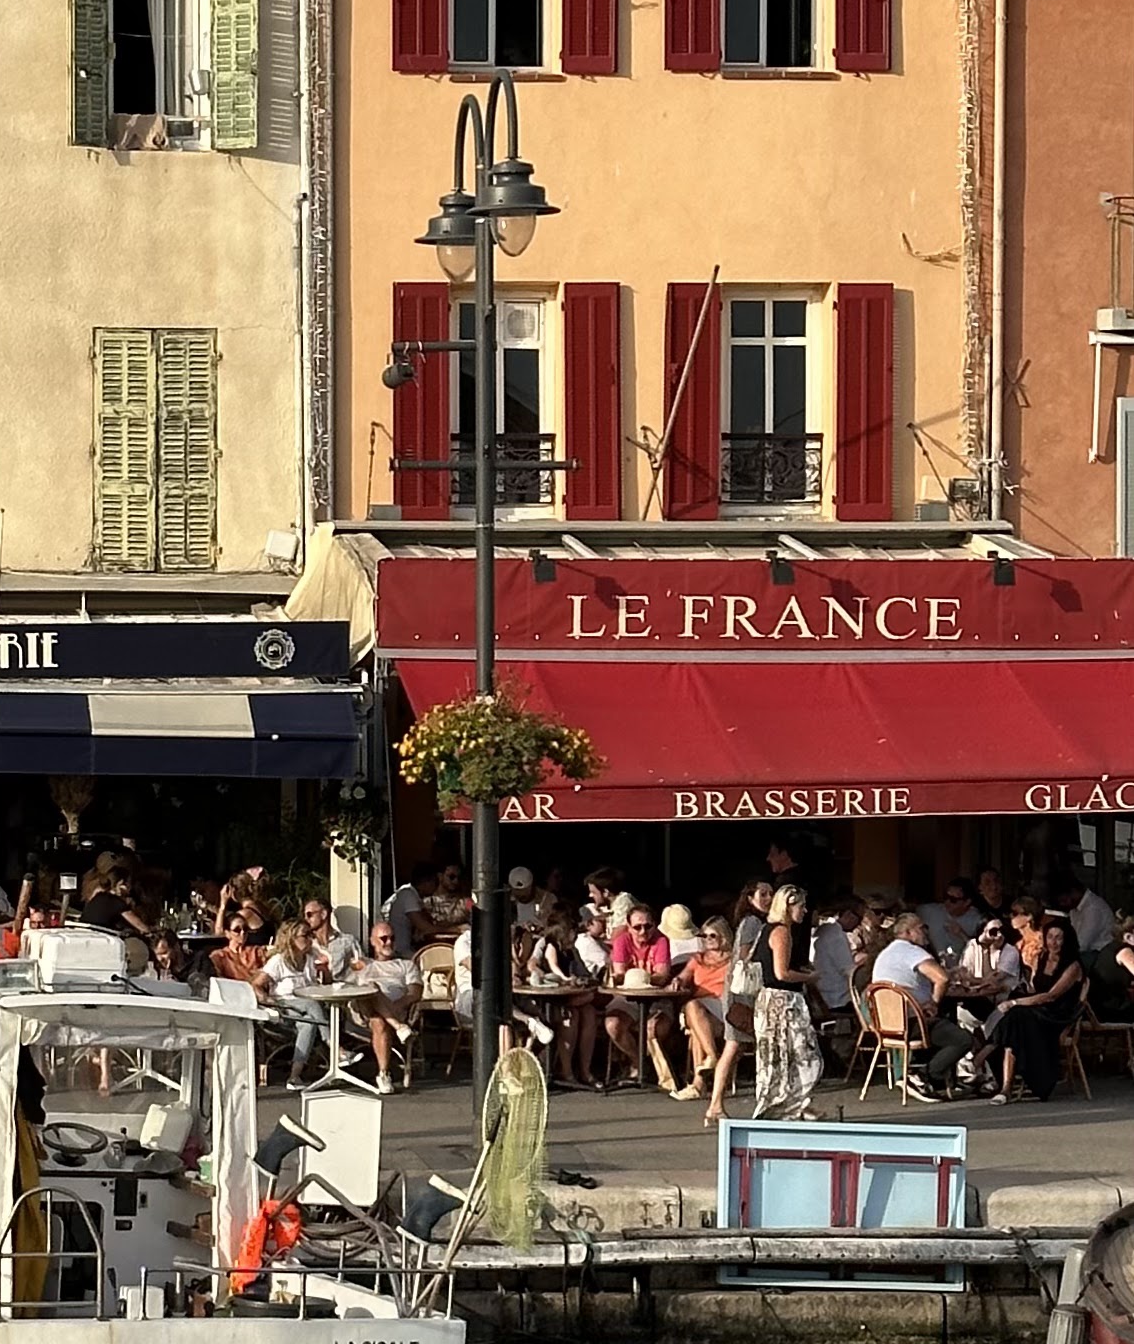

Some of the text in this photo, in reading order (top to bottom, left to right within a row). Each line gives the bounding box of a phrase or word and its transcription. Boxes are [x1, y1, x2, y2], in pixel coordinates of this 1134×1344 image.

[566, 594, 963, 641] LE FRANCE
[500, 793, 560, 821] AR
[674, 787, 912, 819] BRASSERIE
